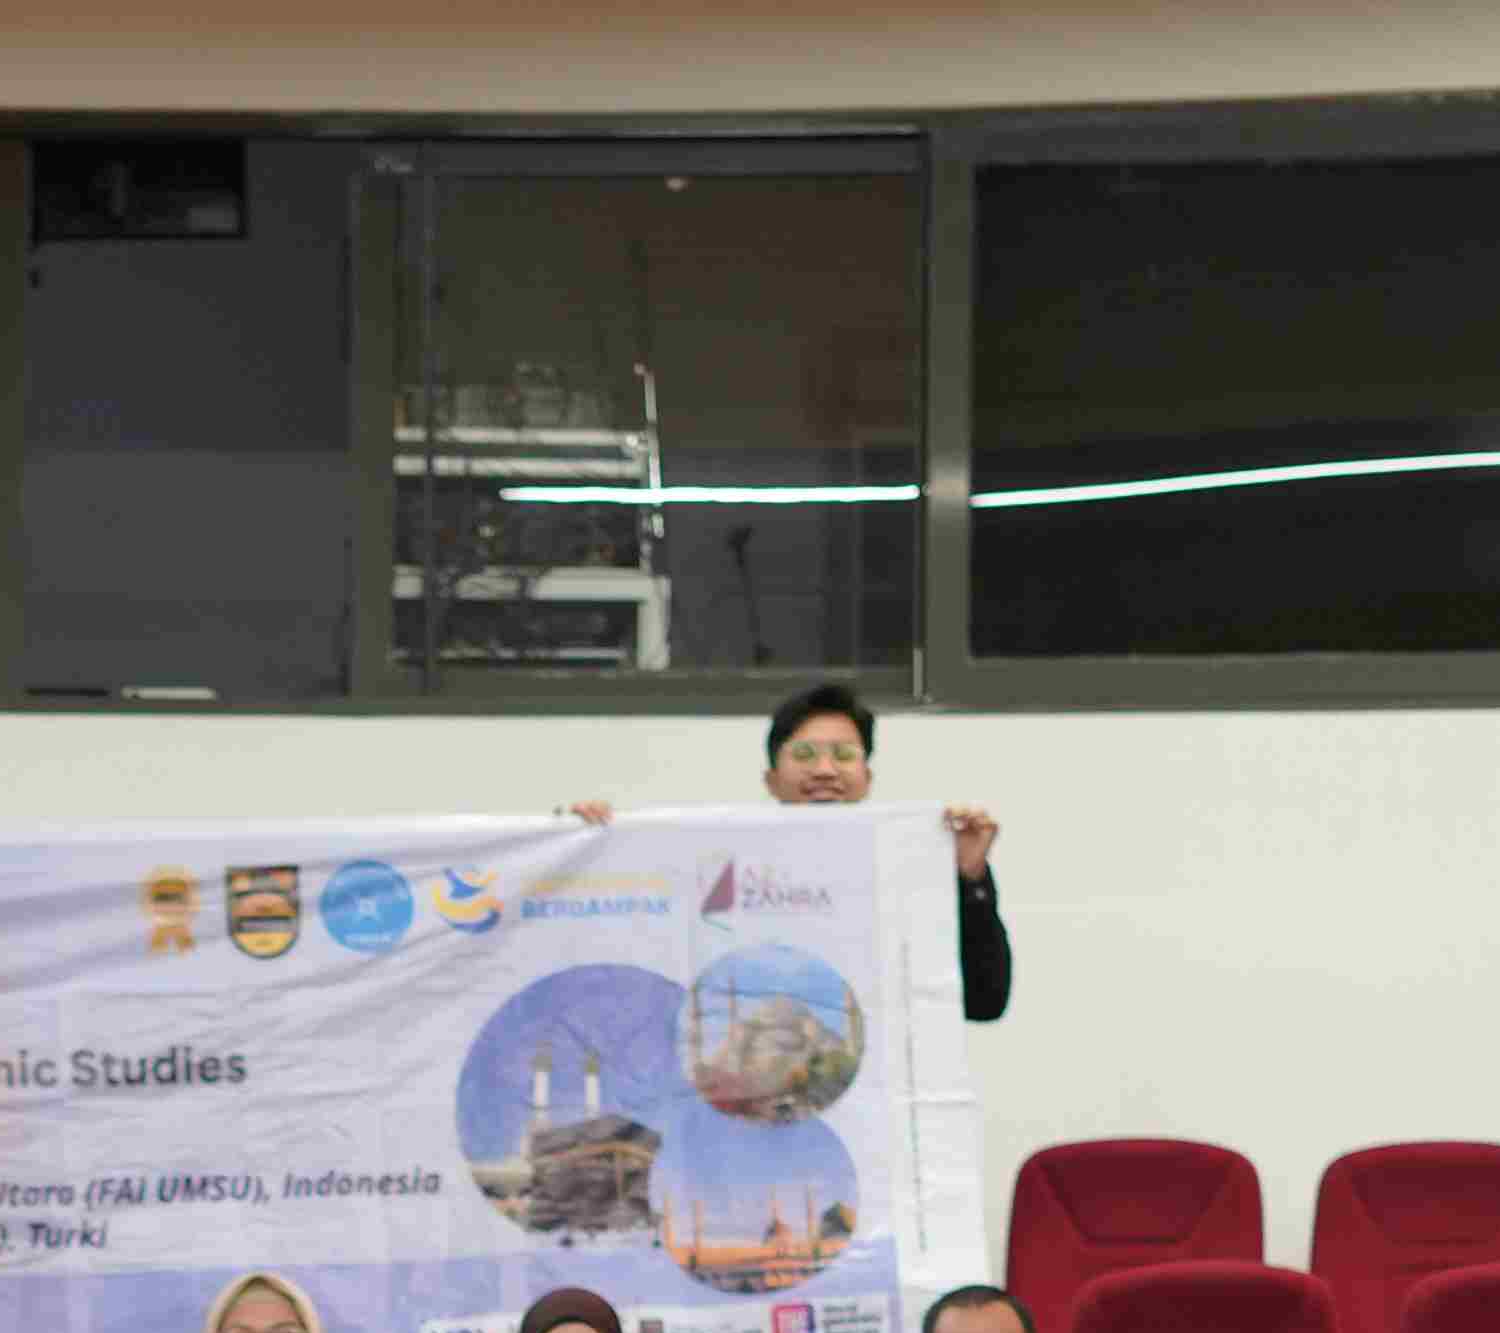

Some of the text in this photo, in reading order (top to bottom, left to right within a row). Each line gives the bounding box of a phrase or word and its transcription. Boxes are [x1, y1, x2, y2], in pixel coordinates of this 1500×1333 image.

[71, 1046, 248, 1088] Studies
[282, 1168, 440, 1201] Indonesia
[27, 1222, 108, 1250] Turki
